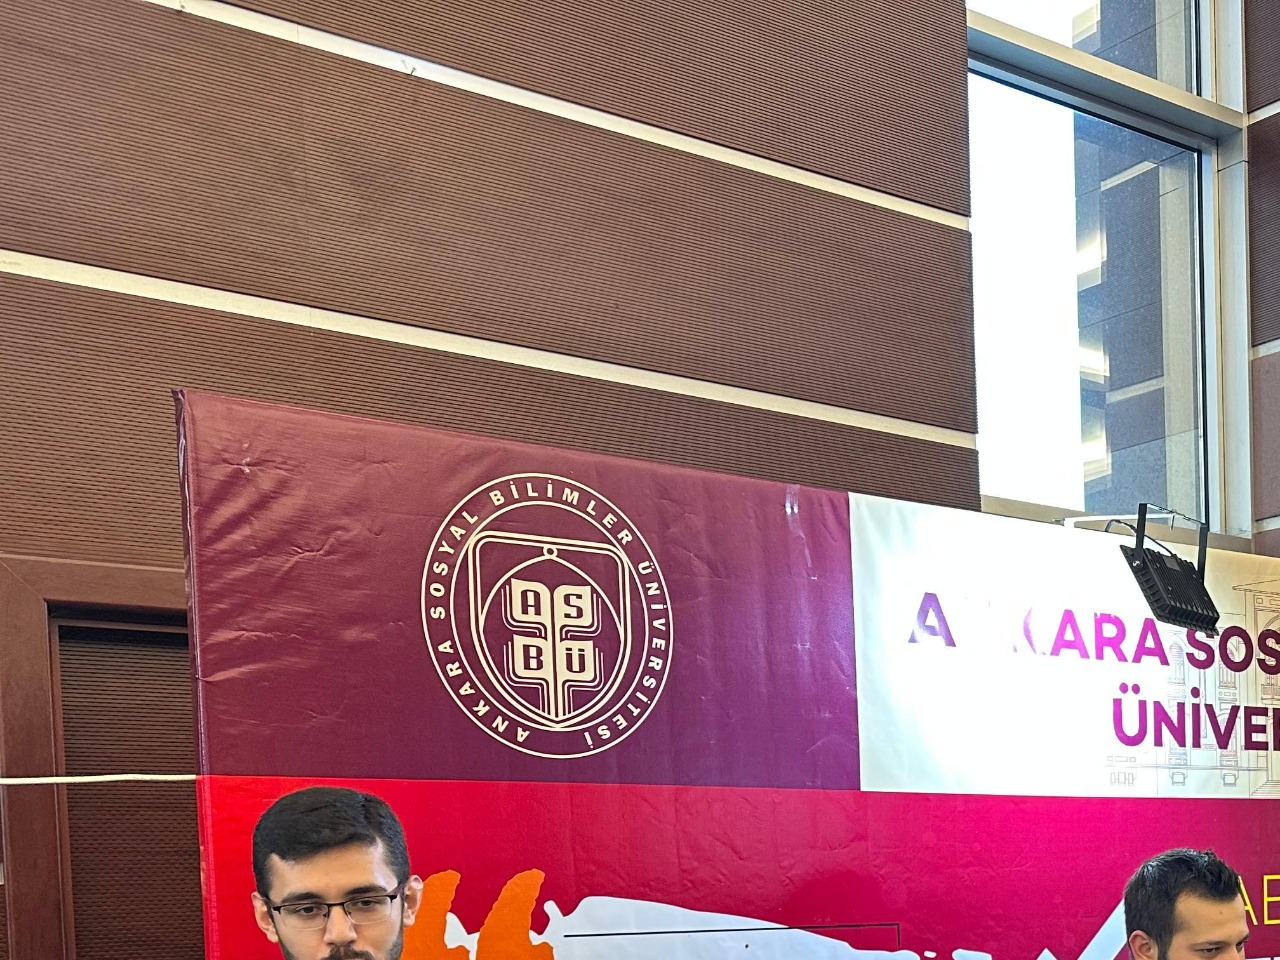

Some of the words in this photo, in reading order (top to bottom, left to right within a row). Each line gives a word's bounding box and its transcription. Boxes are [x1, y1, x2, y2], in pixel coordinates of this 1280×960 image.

[429, 511, 479, 620] SOSYAL
[489, 480, 633, 546] BİLİMLER
[437, 641, 531, 743] ANKARA
[583, 560, 668, 749] ÜNİVERSİTESİ
